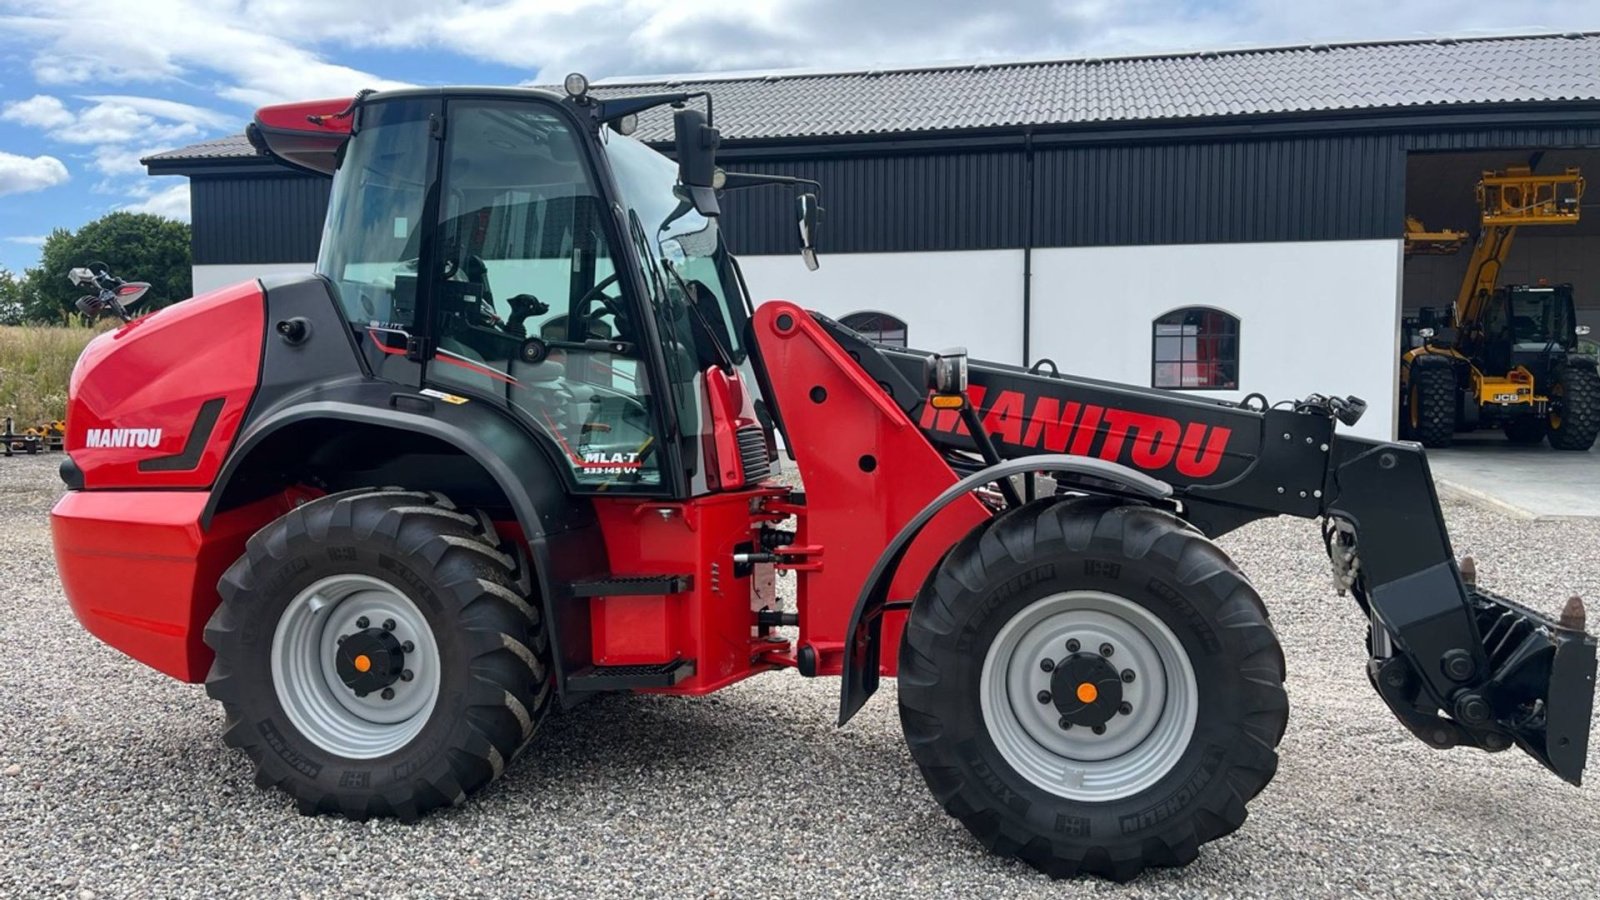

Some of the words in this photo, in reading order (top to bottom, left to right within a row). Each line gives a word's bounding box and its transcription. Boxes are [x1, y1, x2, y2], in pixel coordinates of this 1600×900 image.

[86, 428, 162, 448] MANITOU
[919, 384, 1231, 478] MANITOU
[1120, 765, 1213, 835] MICHELIN
